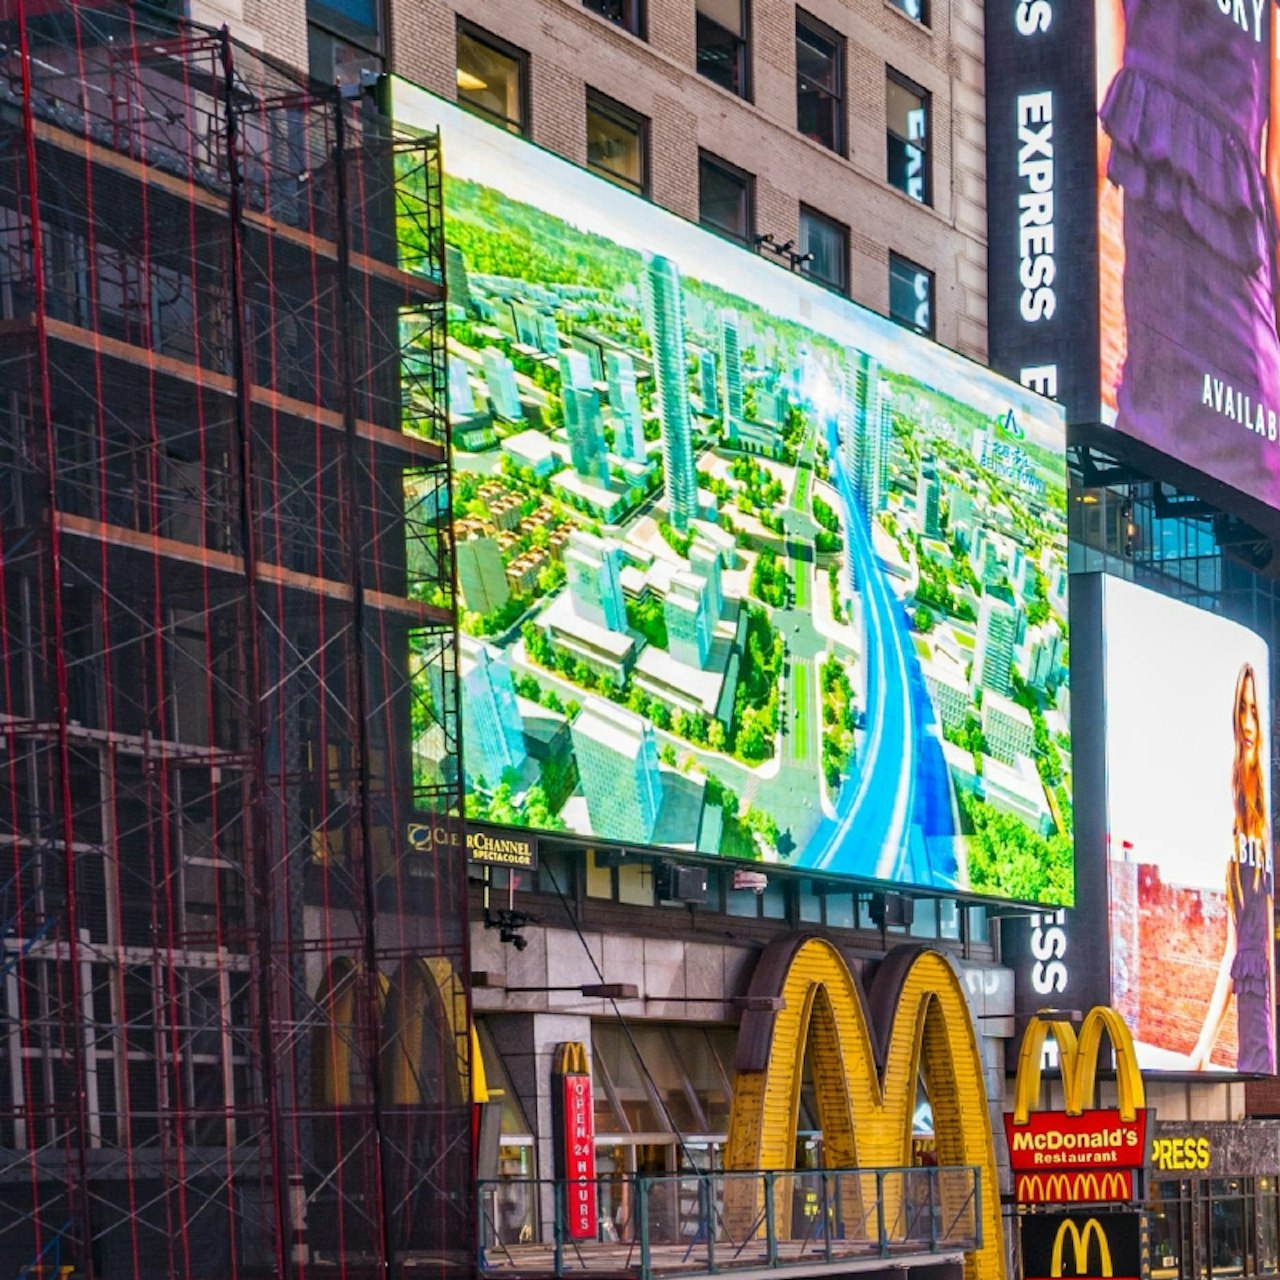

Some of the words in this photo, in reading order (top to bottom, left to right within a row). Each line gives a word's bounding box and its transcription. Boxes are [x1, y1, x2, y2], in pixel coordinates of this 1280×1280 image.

[1017, 91, 1056, 322] EXPRESS
[574, 1084, 585, 1138] OPEN
[574, 1145, 590, 1156] 24
[1013, 1128, 1138, 1150] McDonald's
[1034, 1150, 1117, 1165] Restaurant
[577, 1161, 589, 1230] HOURS
